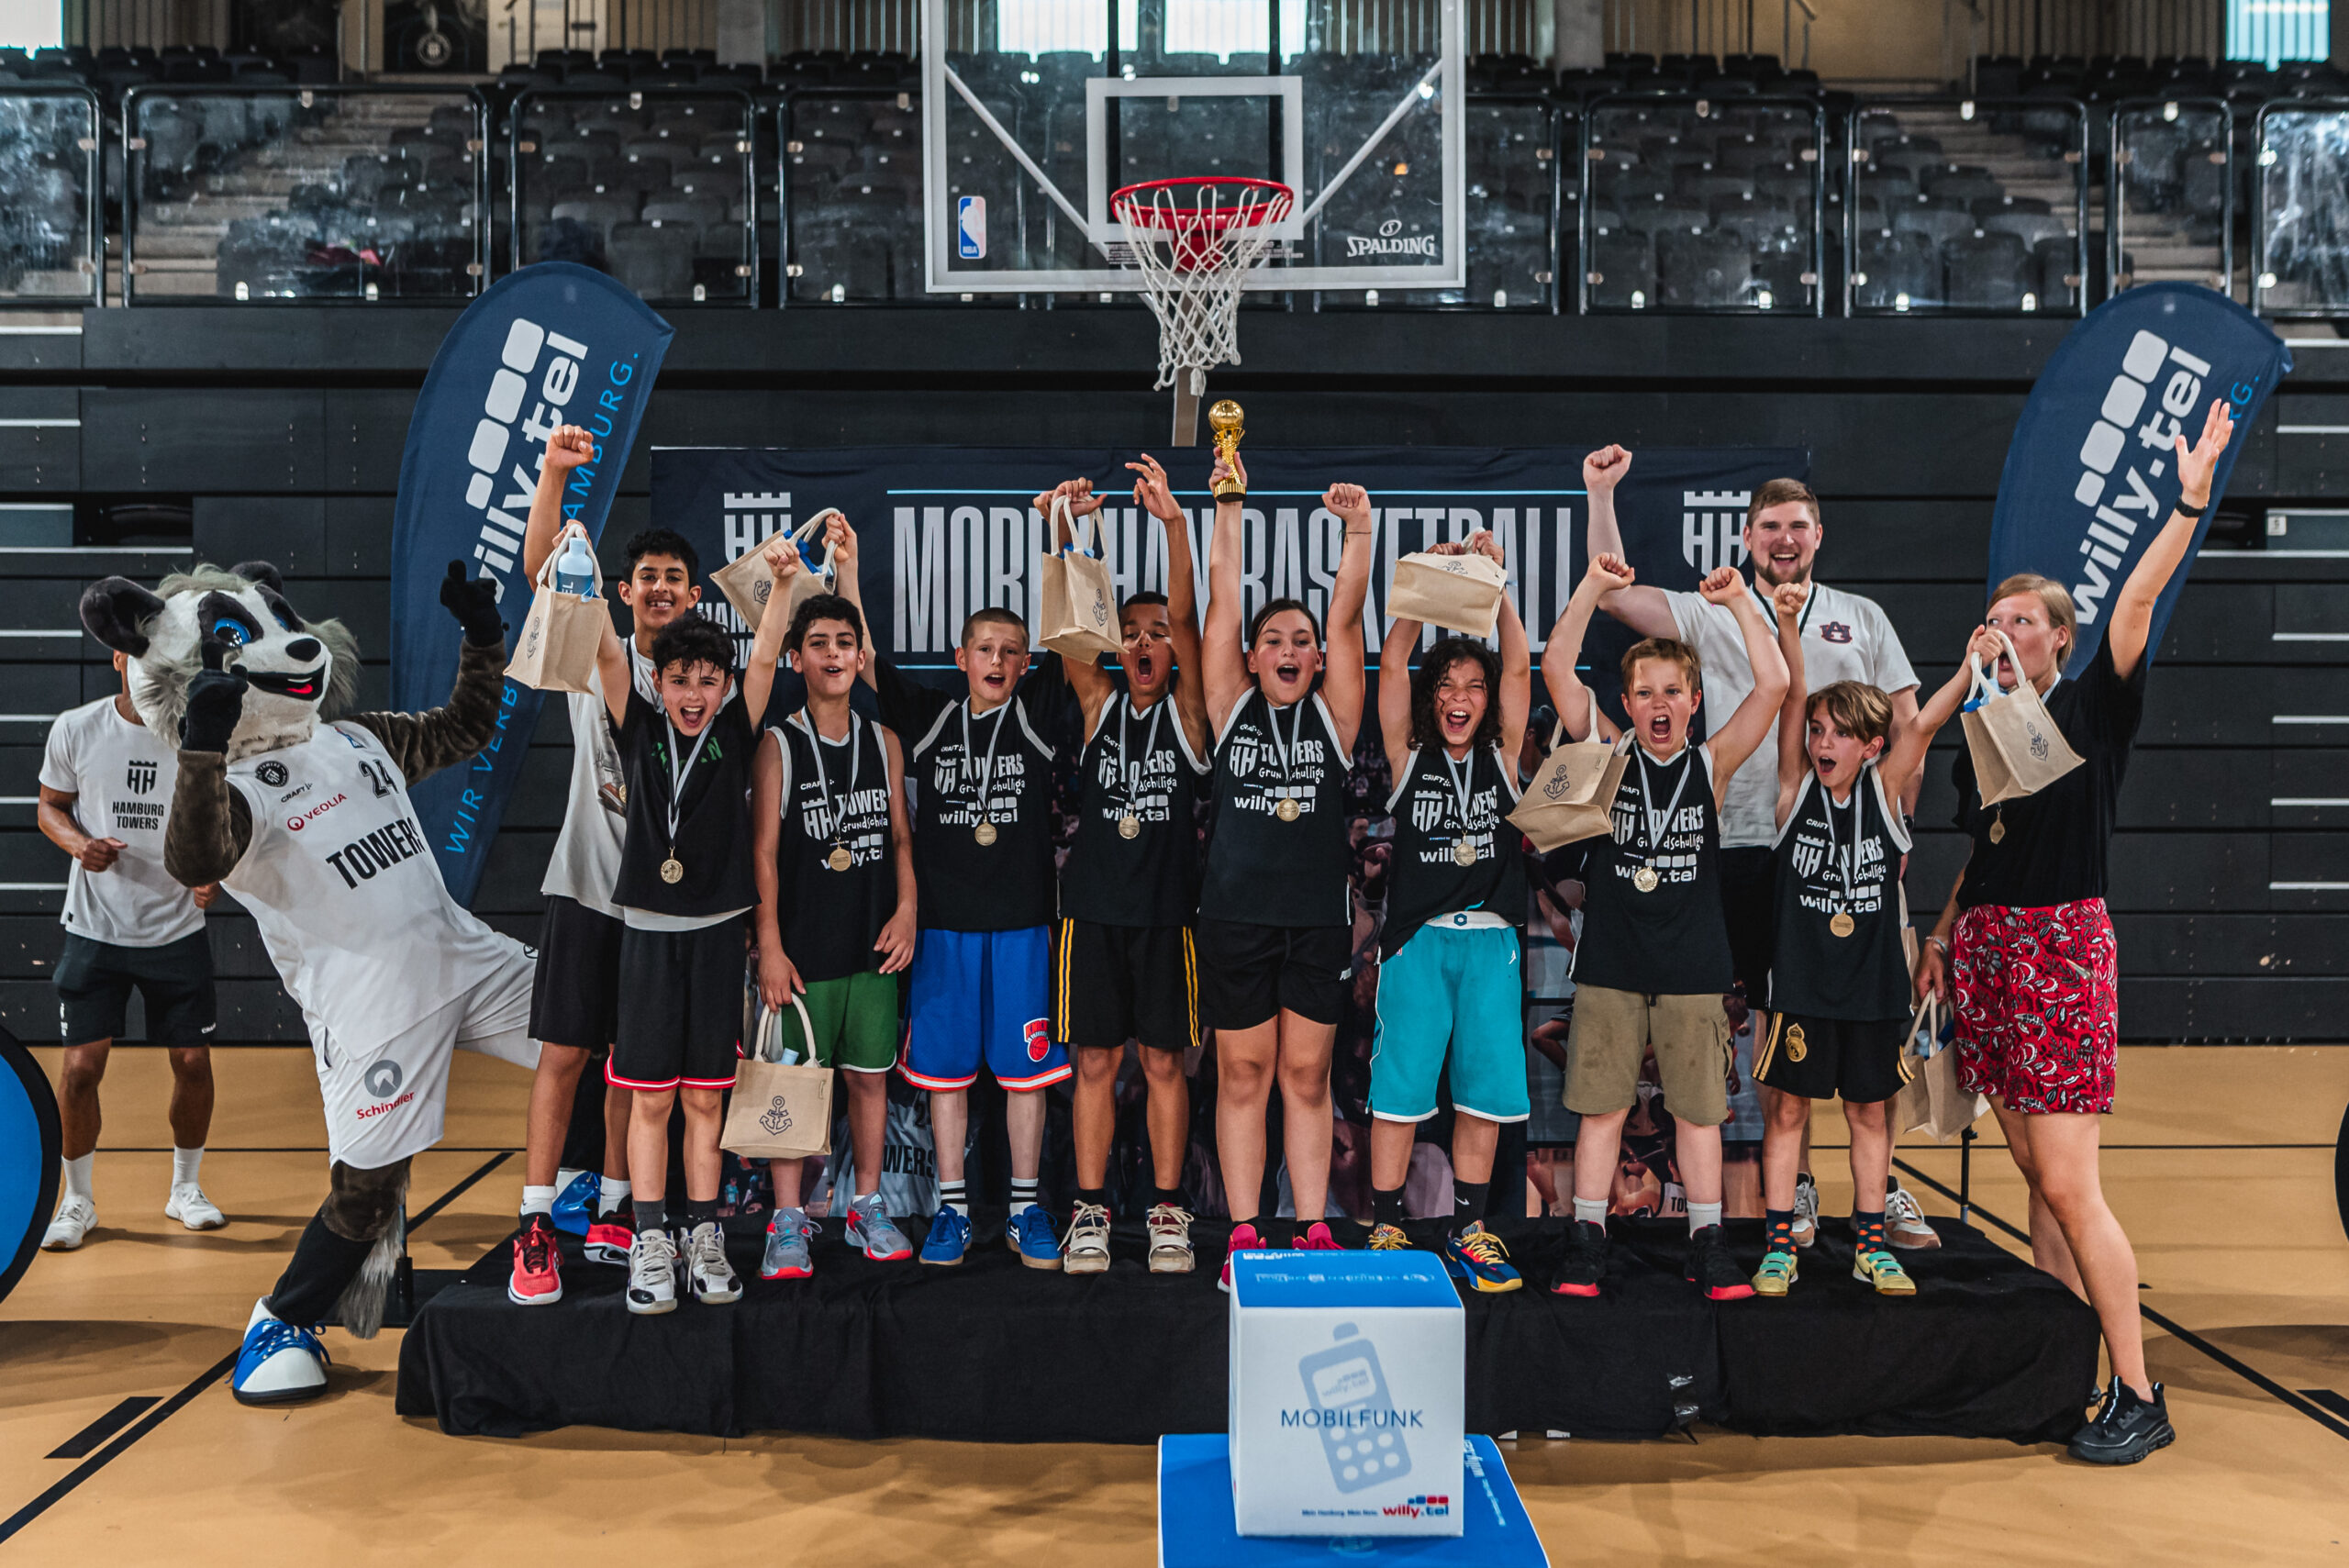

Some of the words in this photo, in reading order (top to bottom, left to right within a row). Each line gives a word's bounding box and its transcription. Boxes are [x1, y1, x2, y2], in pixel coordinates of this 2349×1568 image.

[963, 246, 978, 254] NBA
[1347, 235, 1436, 257] SPALDING
[462, 330, 588, 630] illy.tel
[2074, 346, 2211, 625] willy.tel
[1077, 507, 1215, 652] HAN
[445, 788, 484, 853] WIR
[561, 352, 639, 530] AMBURG.
[128, 768, 156, 795] HH
[800, 781, 822, 790] CRAF
[281, 786, 306, 803] CRAFT
[112, 801, 164, 817] HAMBURG
[304, 793, 348, 820] VEOLIA
[1234, 795, 1315, 816] willyel
[117, 815, 159, 830] TOWERS
[940, 808, 1018, 828] willytel
[1419, 844, 1495, 862] willtel
[1827, 835, 1884, 868] TERS
[1615, 865, 1697, 883] wi.tel
[1799, 895, 1882, 915] willy.tel
[356, 1092, 415, 1119] Schindler
[882, 1145, 935, 1178] WERS
[1281, 1408, 1424, 1429] MOBILFUNK
[1383, 1504, 1449, 1519] willy.tel
